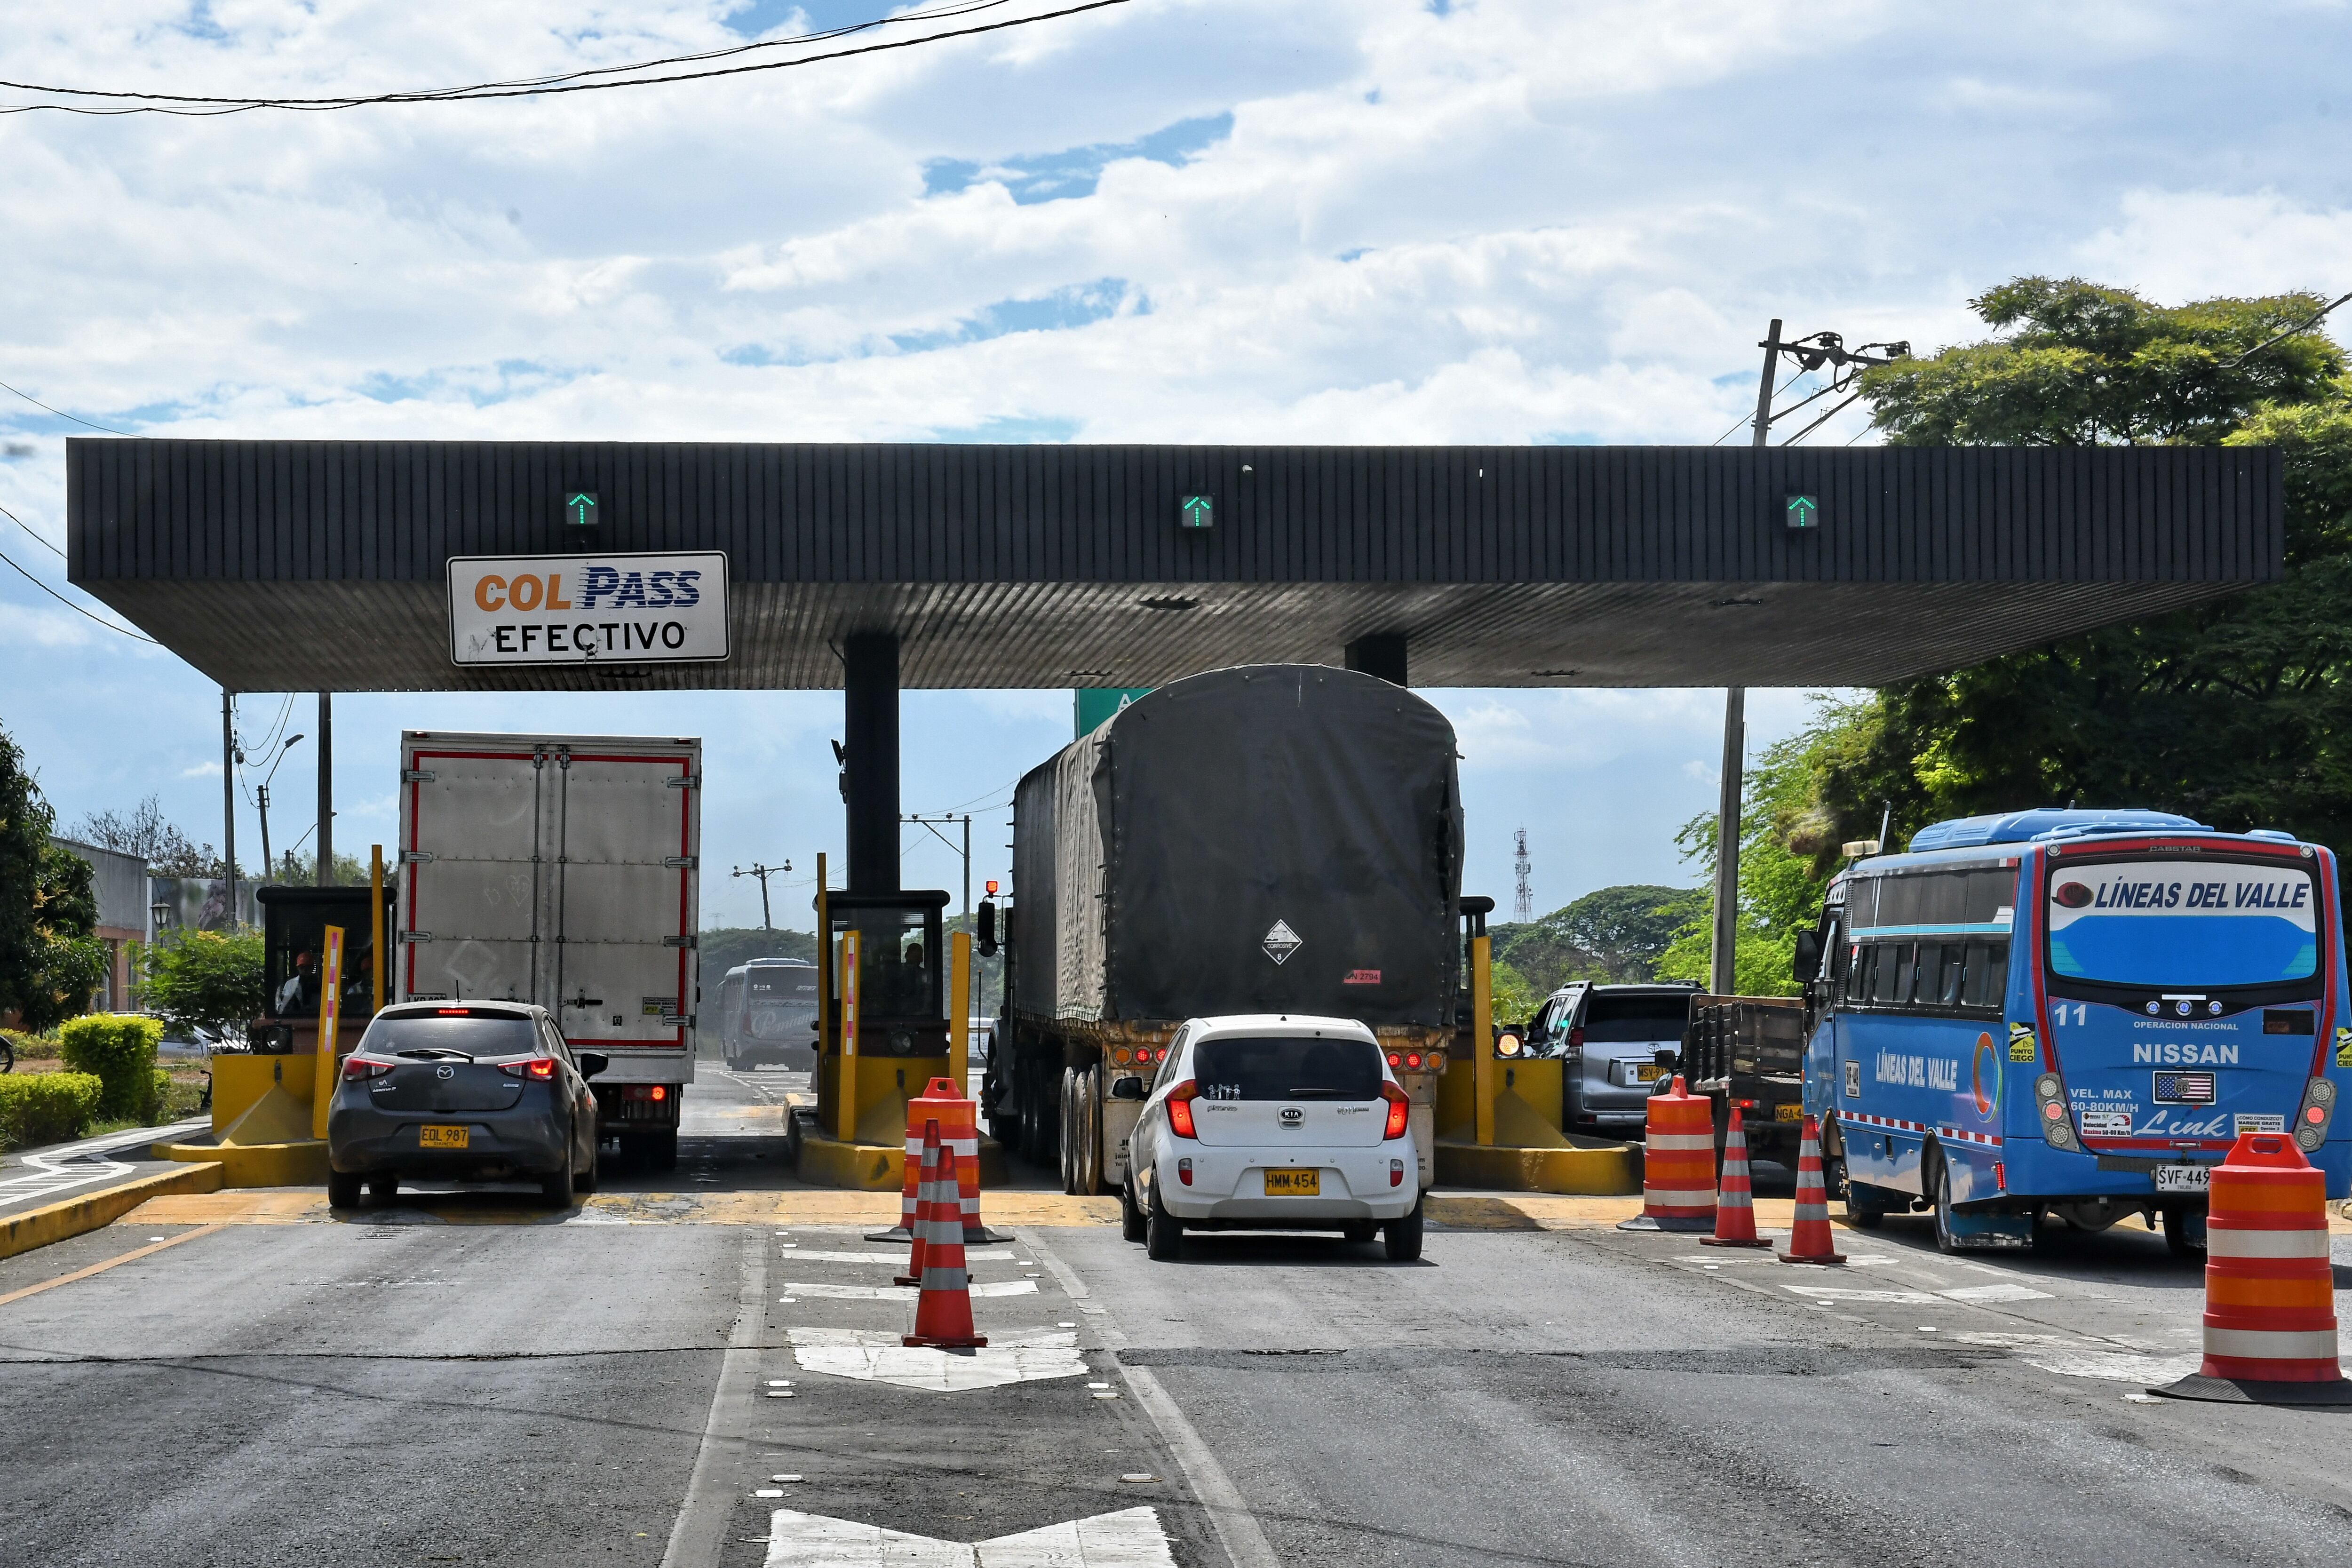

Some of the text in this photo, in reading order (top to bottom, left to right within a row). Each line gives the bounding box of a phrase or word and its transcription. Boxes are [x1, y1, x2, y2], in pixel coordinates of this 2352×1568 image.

[475, 566, 701, 612] COL PASS
[495, 621, 685, 653] EFECTIVO
[2095, 876, 2310, 908] LÍNEAS DEL VALLE
[2054, 1004, 2086, 1026] 11
[2133, 1044, 2239, 1064] NISSAN
[1875, 1047, 1958, 1091] LÍNEAS DEL VALLE
[2071, 1089, 2132, 1099] VEL. MAX
[2071, 1101, 2138, 1113] 60-80KM/H
